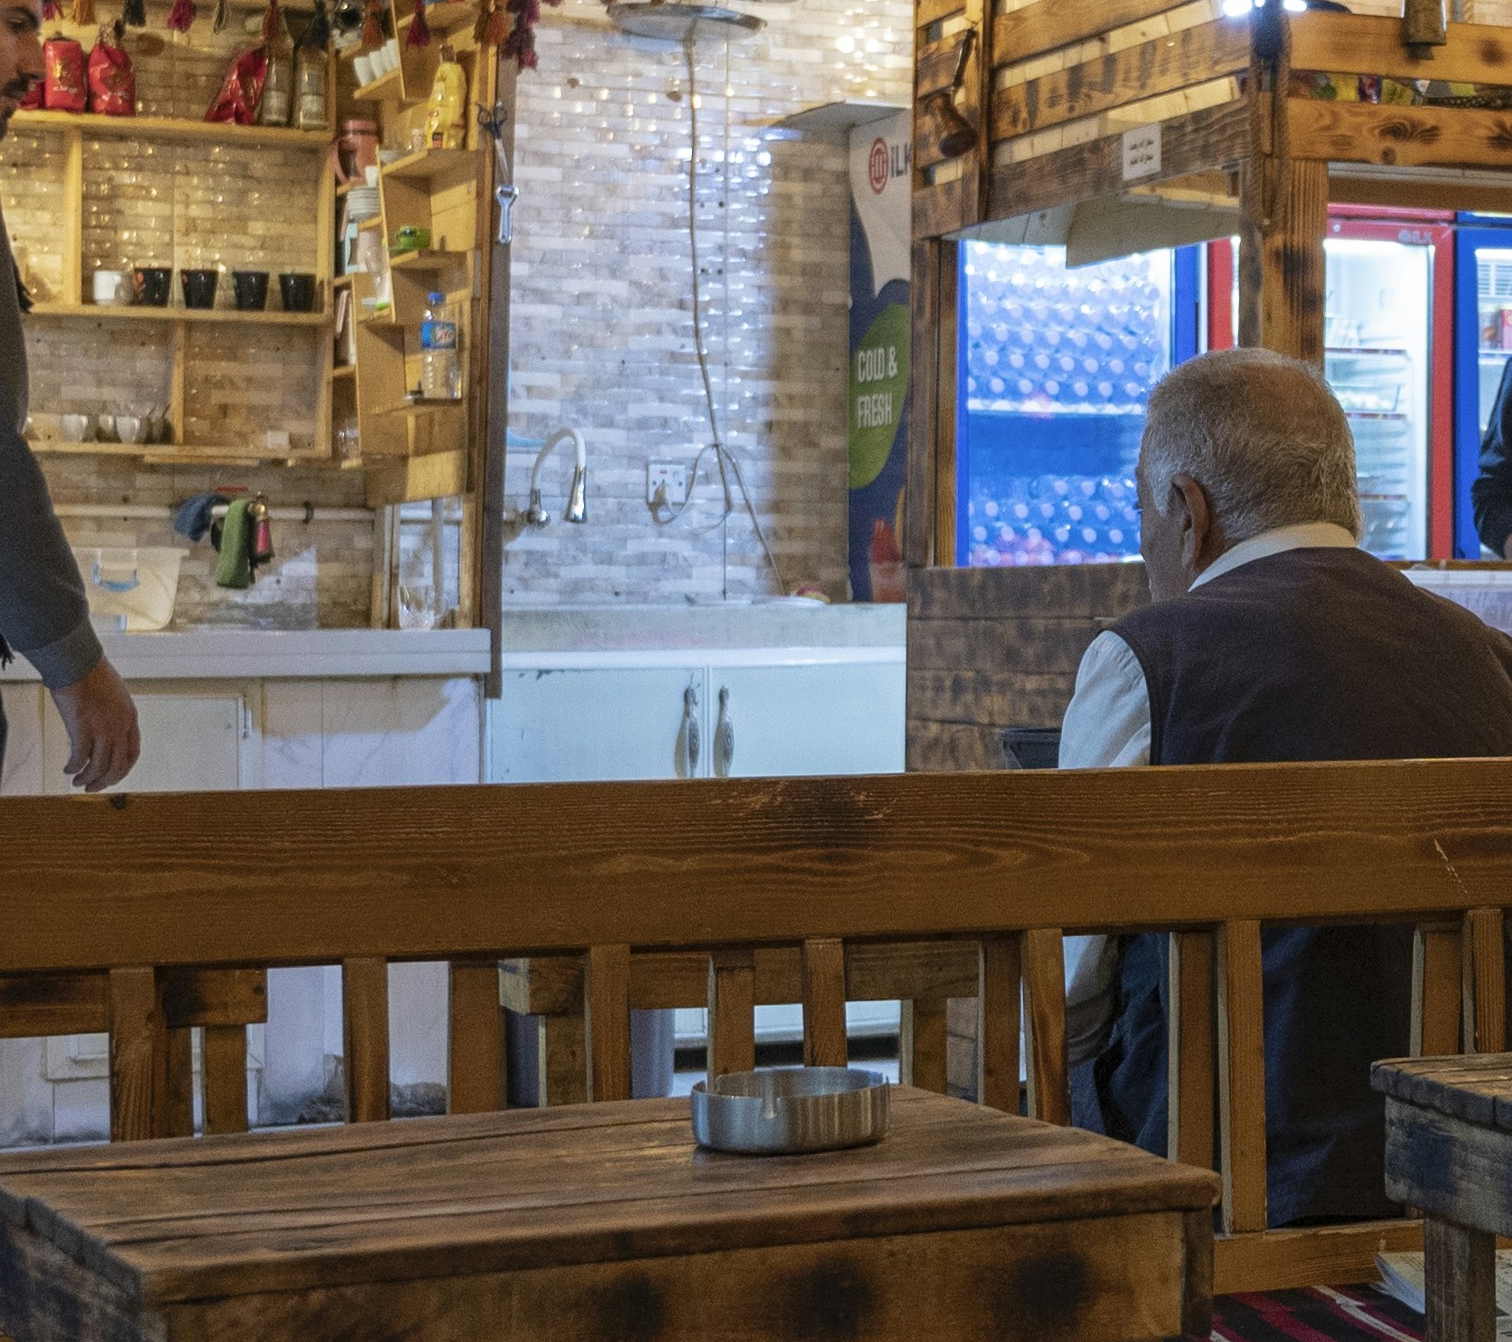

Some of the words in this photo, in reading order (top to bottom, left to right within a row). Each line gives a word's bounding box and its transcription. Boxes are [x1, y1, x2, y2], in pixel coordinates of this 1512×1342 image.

[858, 347, 885, 382] COLD
[888, 345, 898, 378] &
[856, 390, 893, 429] FRESH
